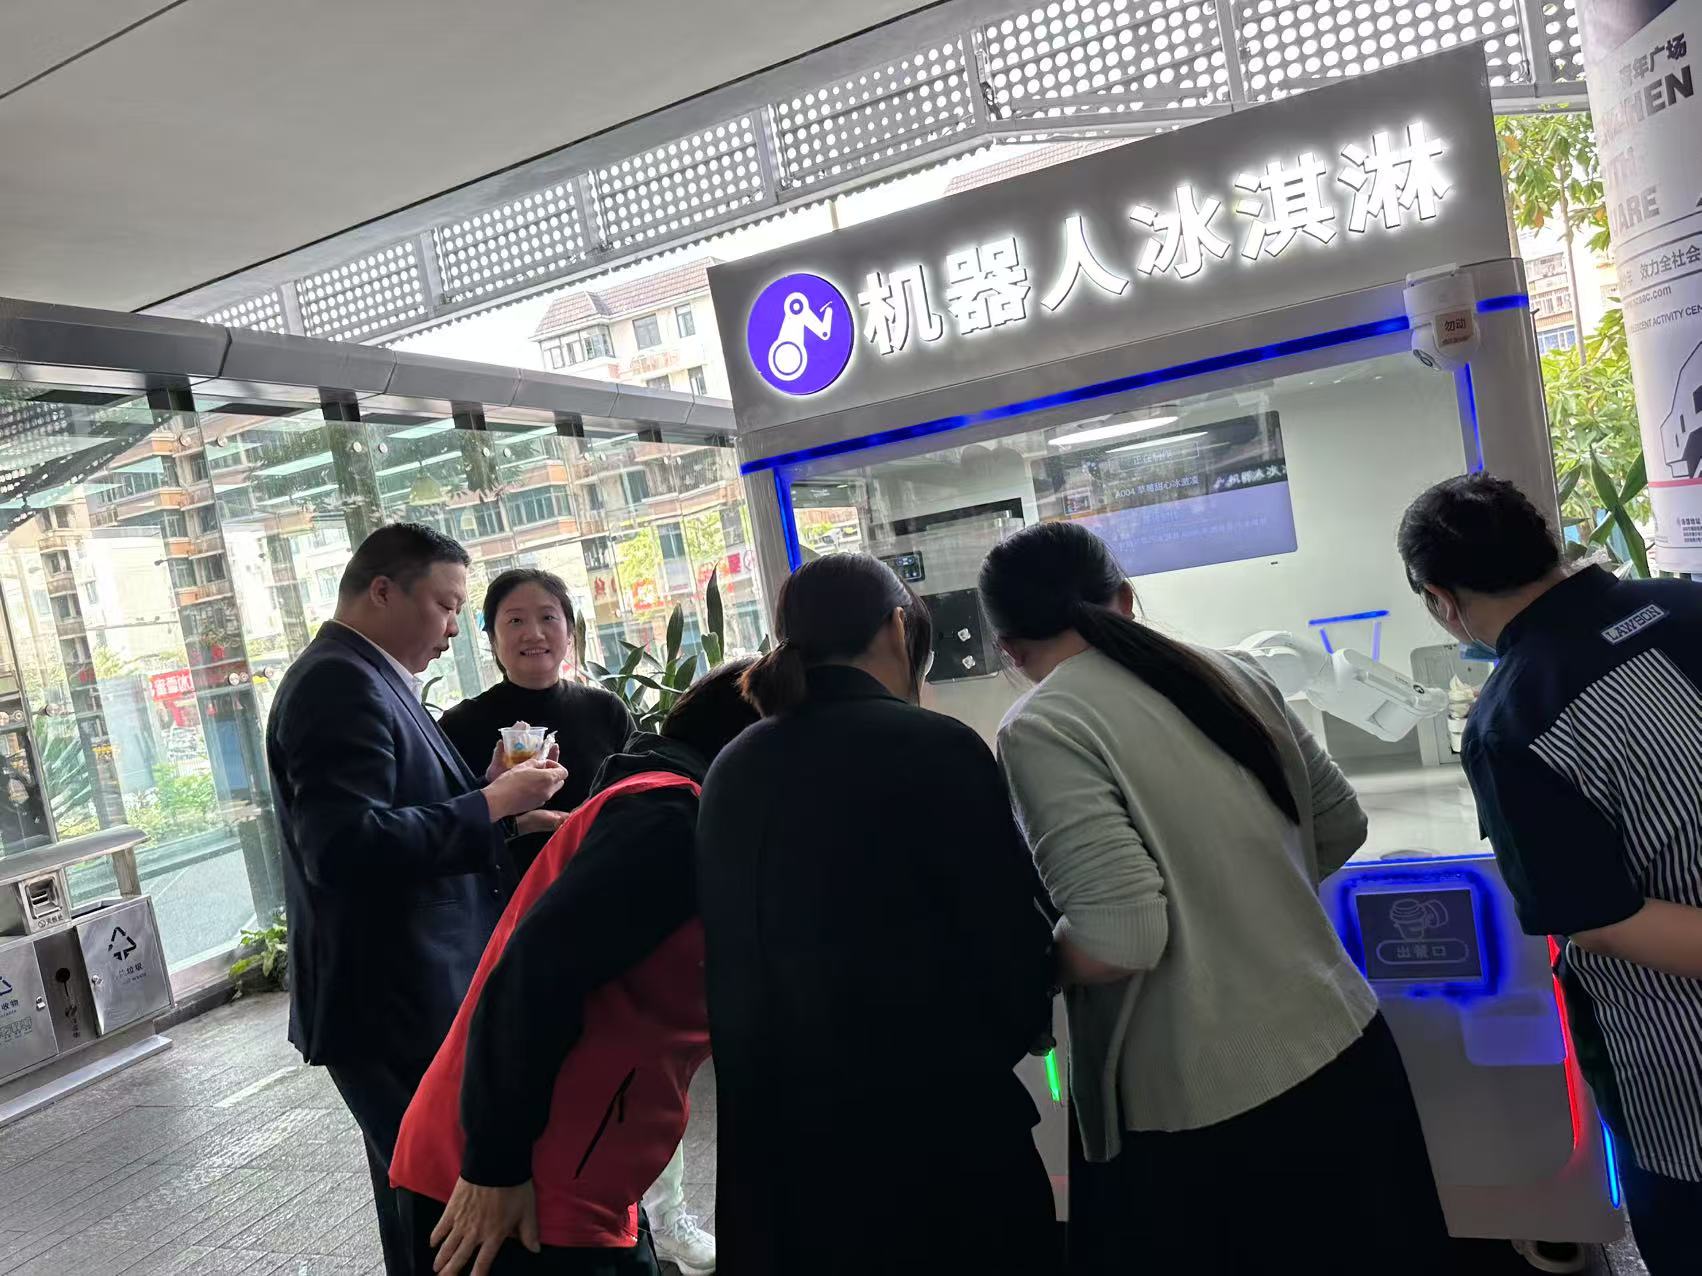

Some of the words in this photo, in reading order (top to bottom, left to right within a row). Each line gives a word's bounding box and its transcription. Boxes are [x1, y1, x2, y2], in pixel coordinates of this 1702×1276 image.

[858, 120, 1454, 357] 机器人冰淇淋
[1639, 244, 1702, 281] 效力全社会
[1445, 318, 1467, 332] 勿动
[1652, 308, 1684, 327] ACTIVITY
[1115, 488, 1136, 499] A004
[1396, 945, 1447, 959] 出餐口
